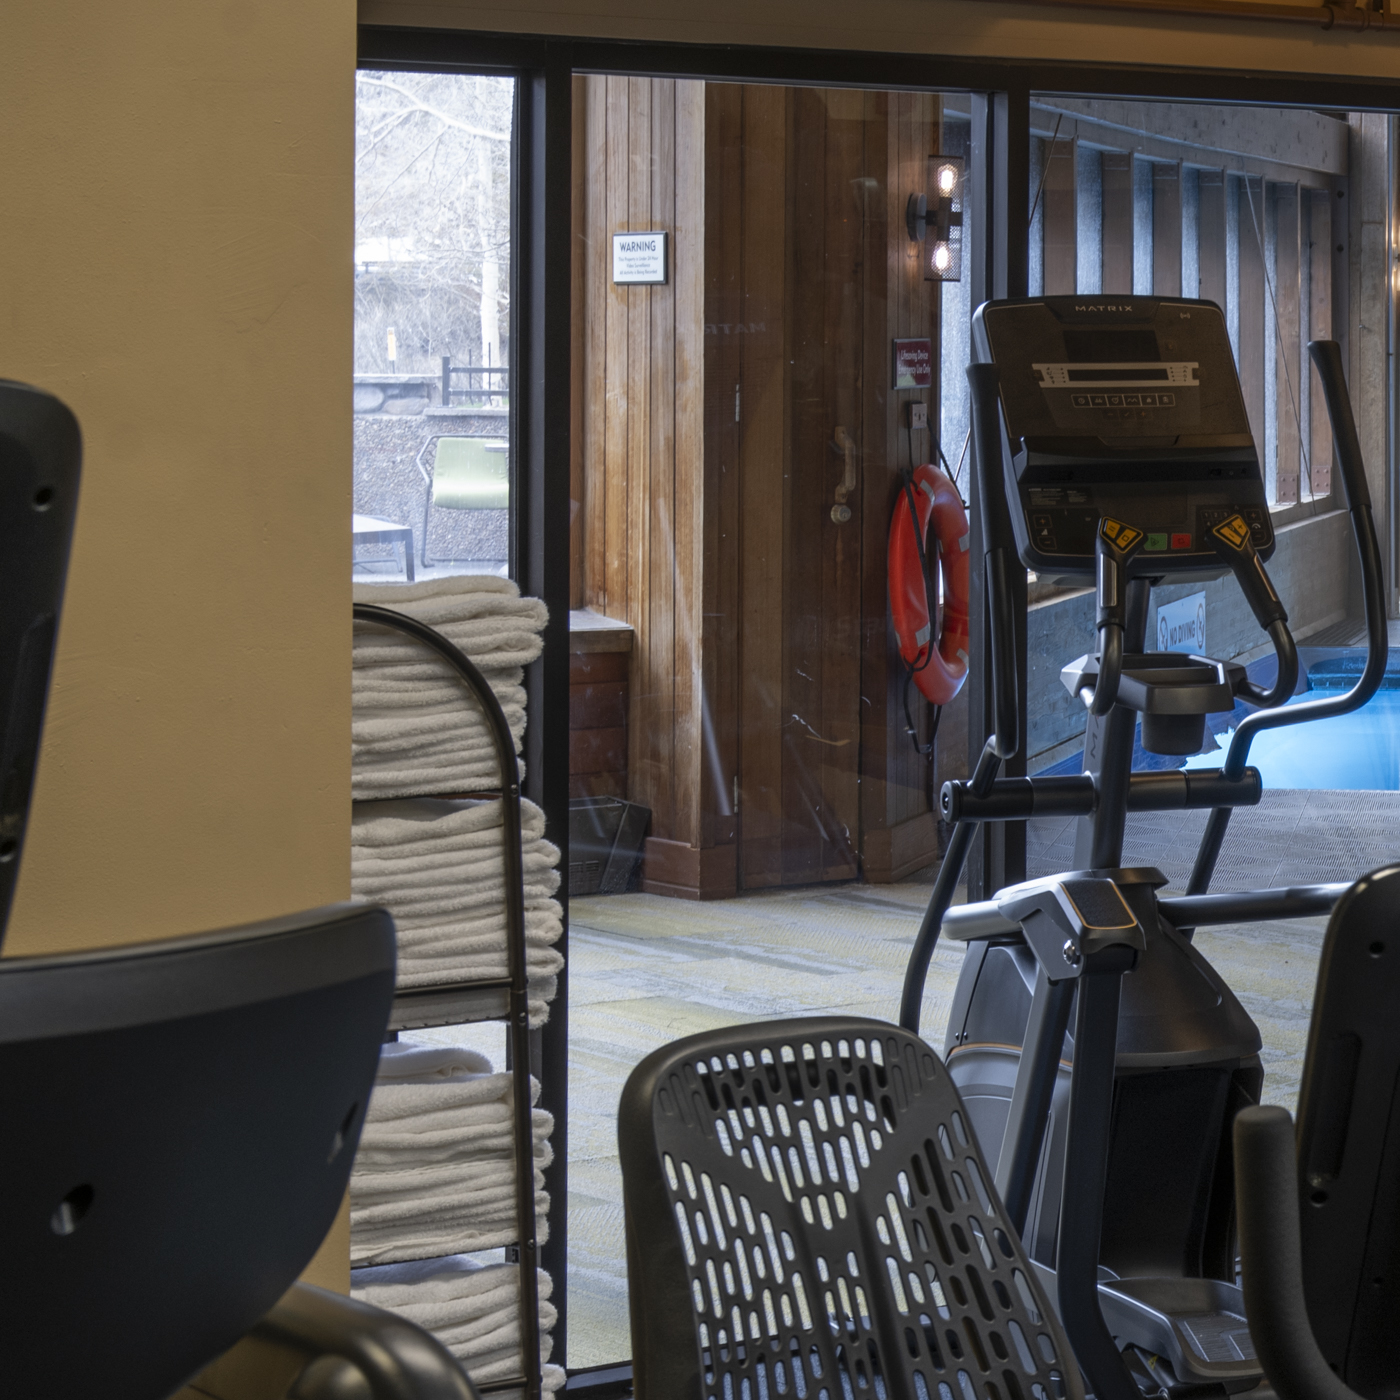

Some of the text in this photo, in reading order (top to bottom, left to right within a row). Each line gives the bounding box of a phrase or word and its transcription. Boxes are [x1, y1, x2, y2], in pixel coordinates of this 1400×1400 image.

[620, 240, 656, 252] WARNING
[1170, 620, 1195, 647] NO DIVING
